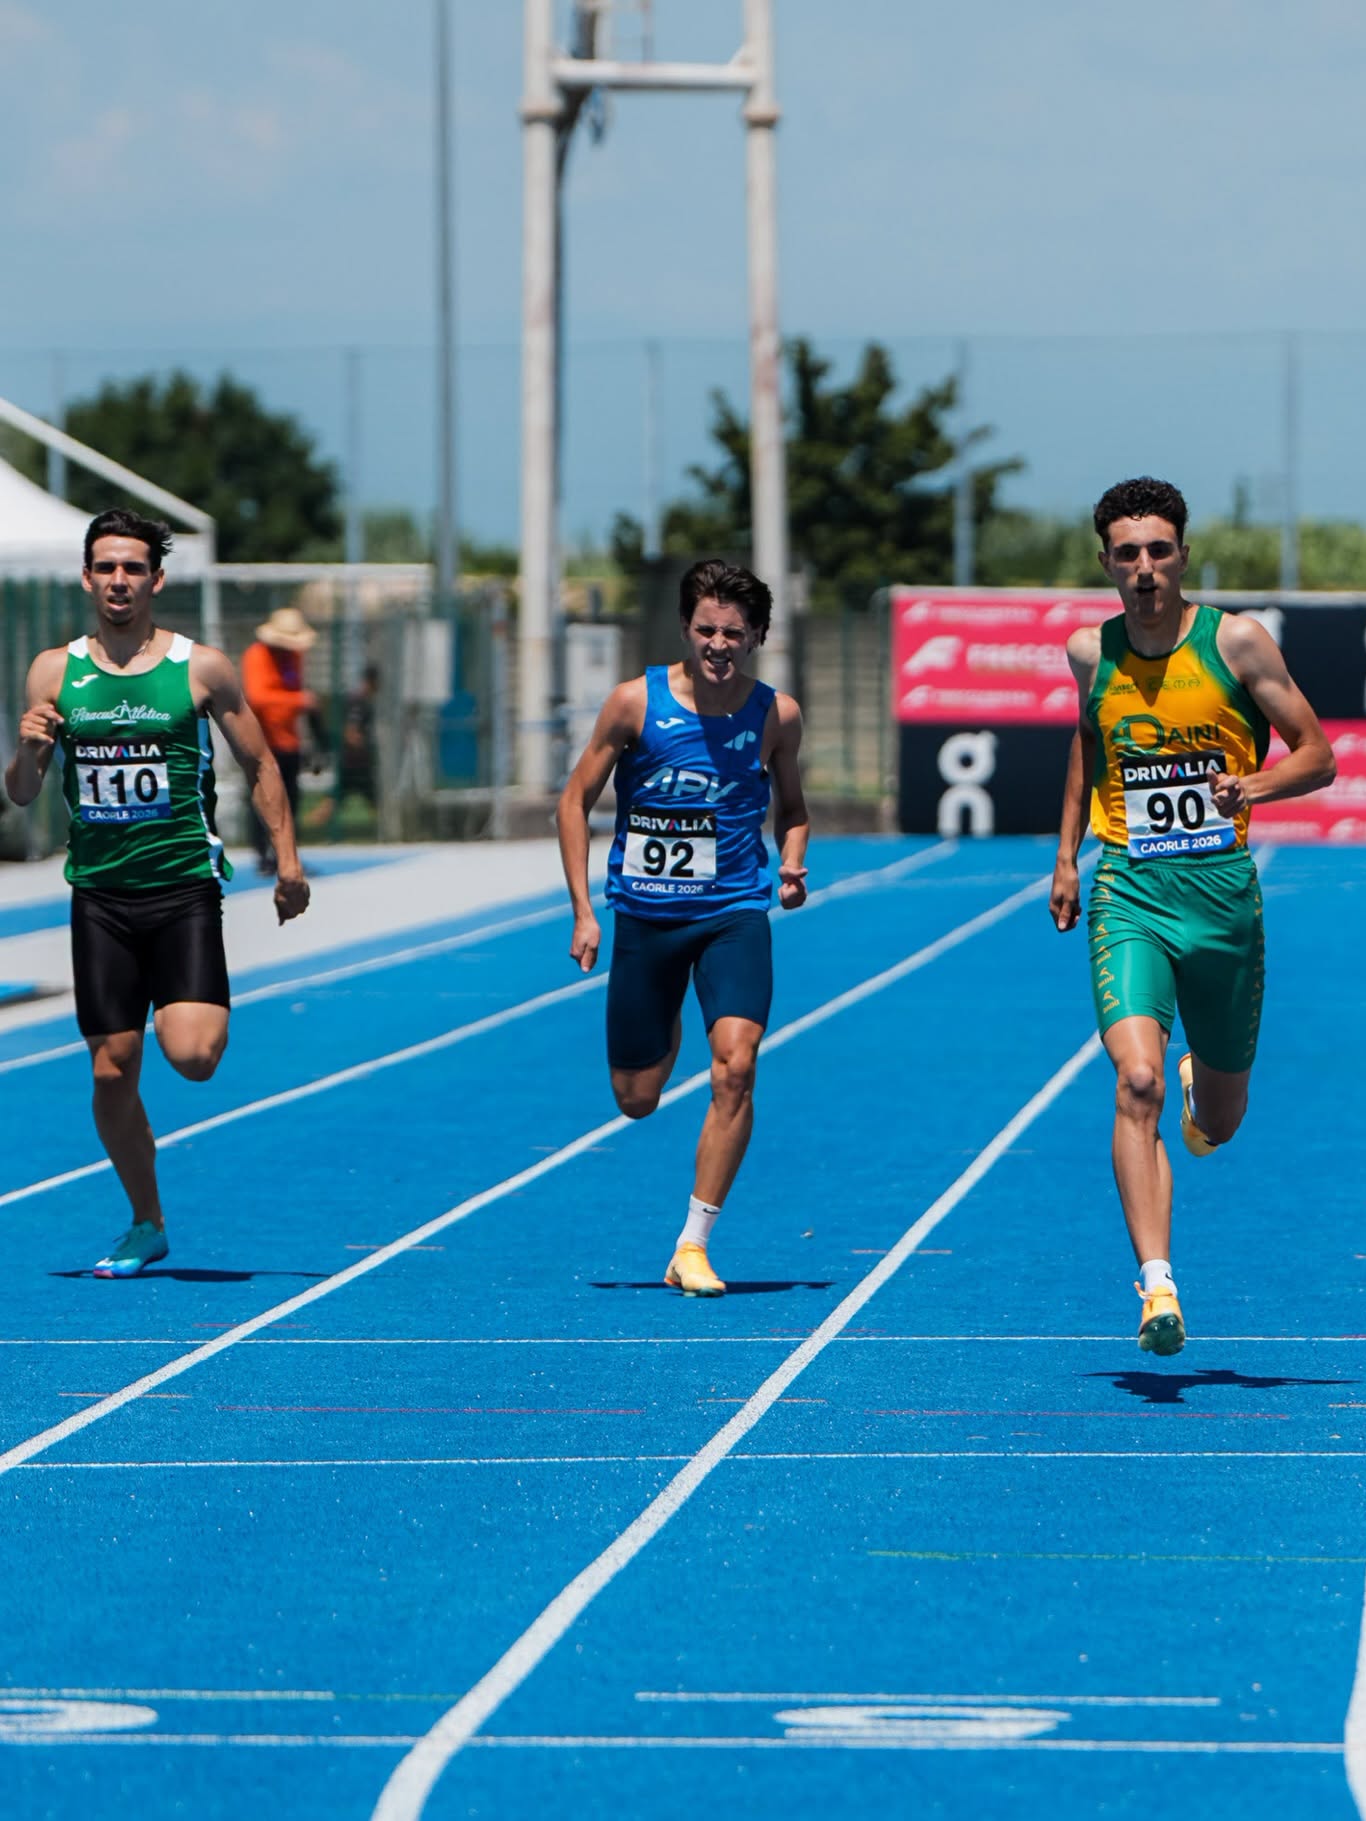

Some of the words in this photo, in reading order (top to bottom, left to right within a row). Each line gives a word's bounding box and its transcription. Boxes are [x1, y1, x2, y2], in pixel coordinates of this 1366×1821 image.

[75, 743, 162, 759] DRIVALIA
[1123, 759, 1221, 783] DRIVALIA
[86, 768, 159, 804] 110
[88, 808, 129, 820] CAORLE
[1147, 789, 1205, 834] 90
[629, 814, 713, 832] DRIVALIA
[1140, 838, 1189, 854] CAORLE
[1192, 834, 1222, 849] 2026
[643, 839, 695, 878] 92
[631, 881, 676, 894] CAORLE
[677, 883, 704, 894] 2026
